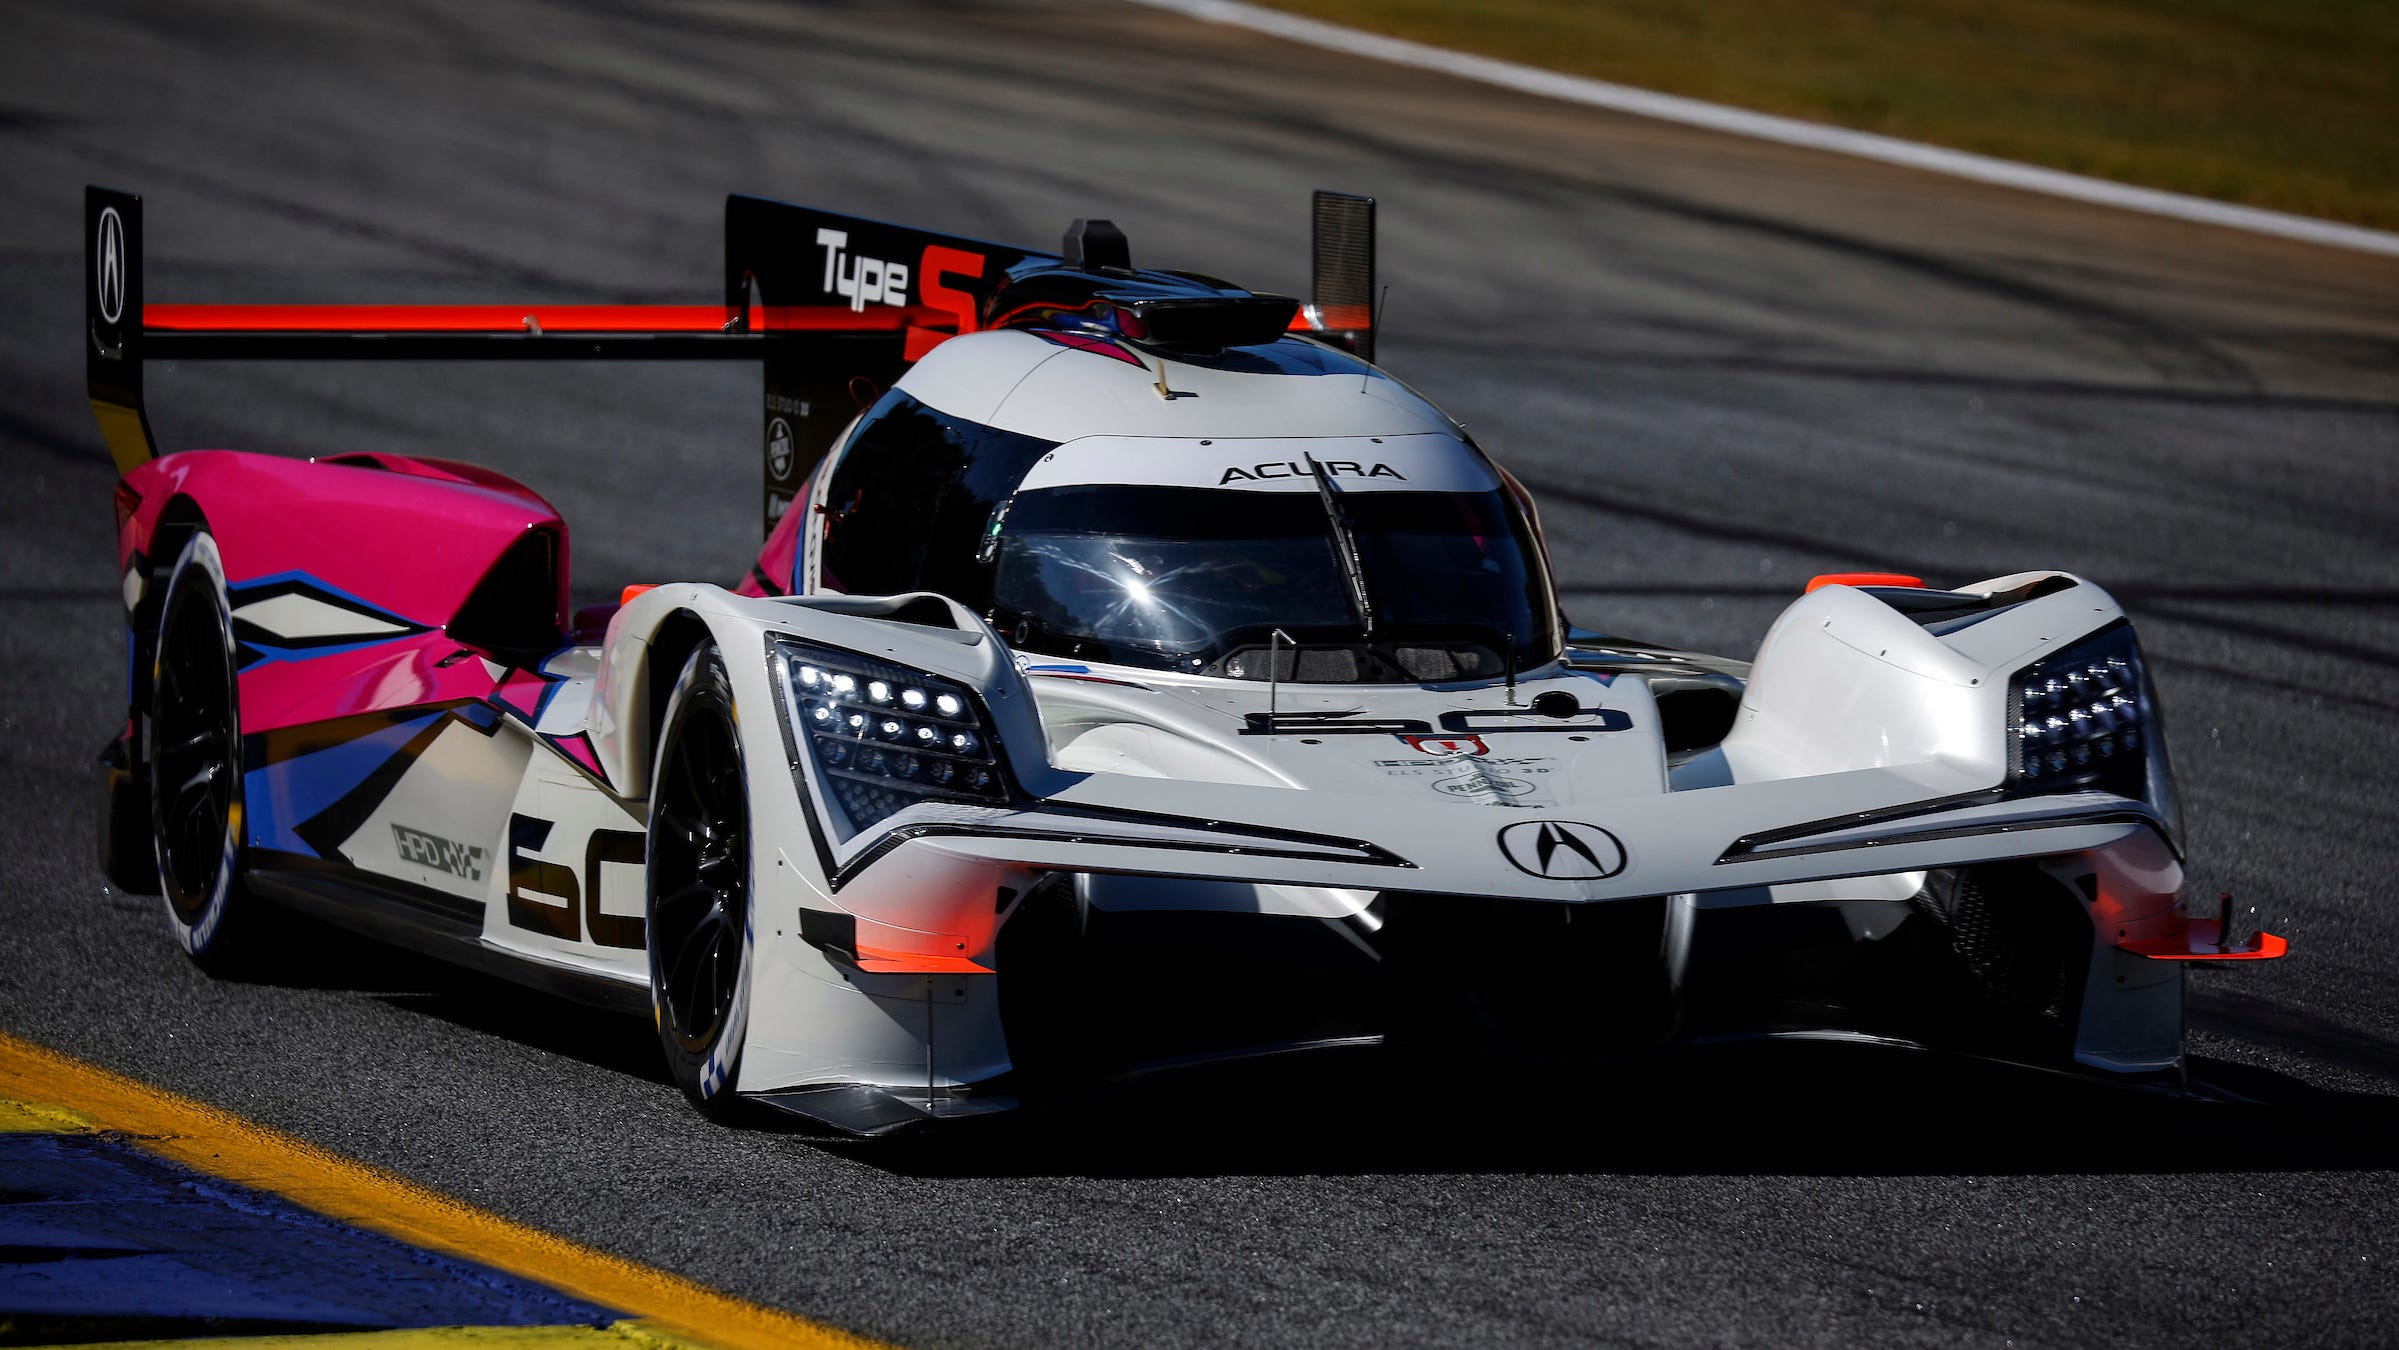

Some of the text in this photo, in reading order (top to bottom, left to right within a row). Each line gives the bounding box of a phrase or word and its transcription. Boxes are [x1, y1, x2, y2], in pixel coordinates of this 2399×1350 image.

[816, 227, 986, 362] Type S
[1218, 460, 1408, 486] ACURA
[1432, 765, 1511, 776] STUIO
[1447, 778, 1520, 793] PENNOIL
[393, 827, 441, 867] HPD
